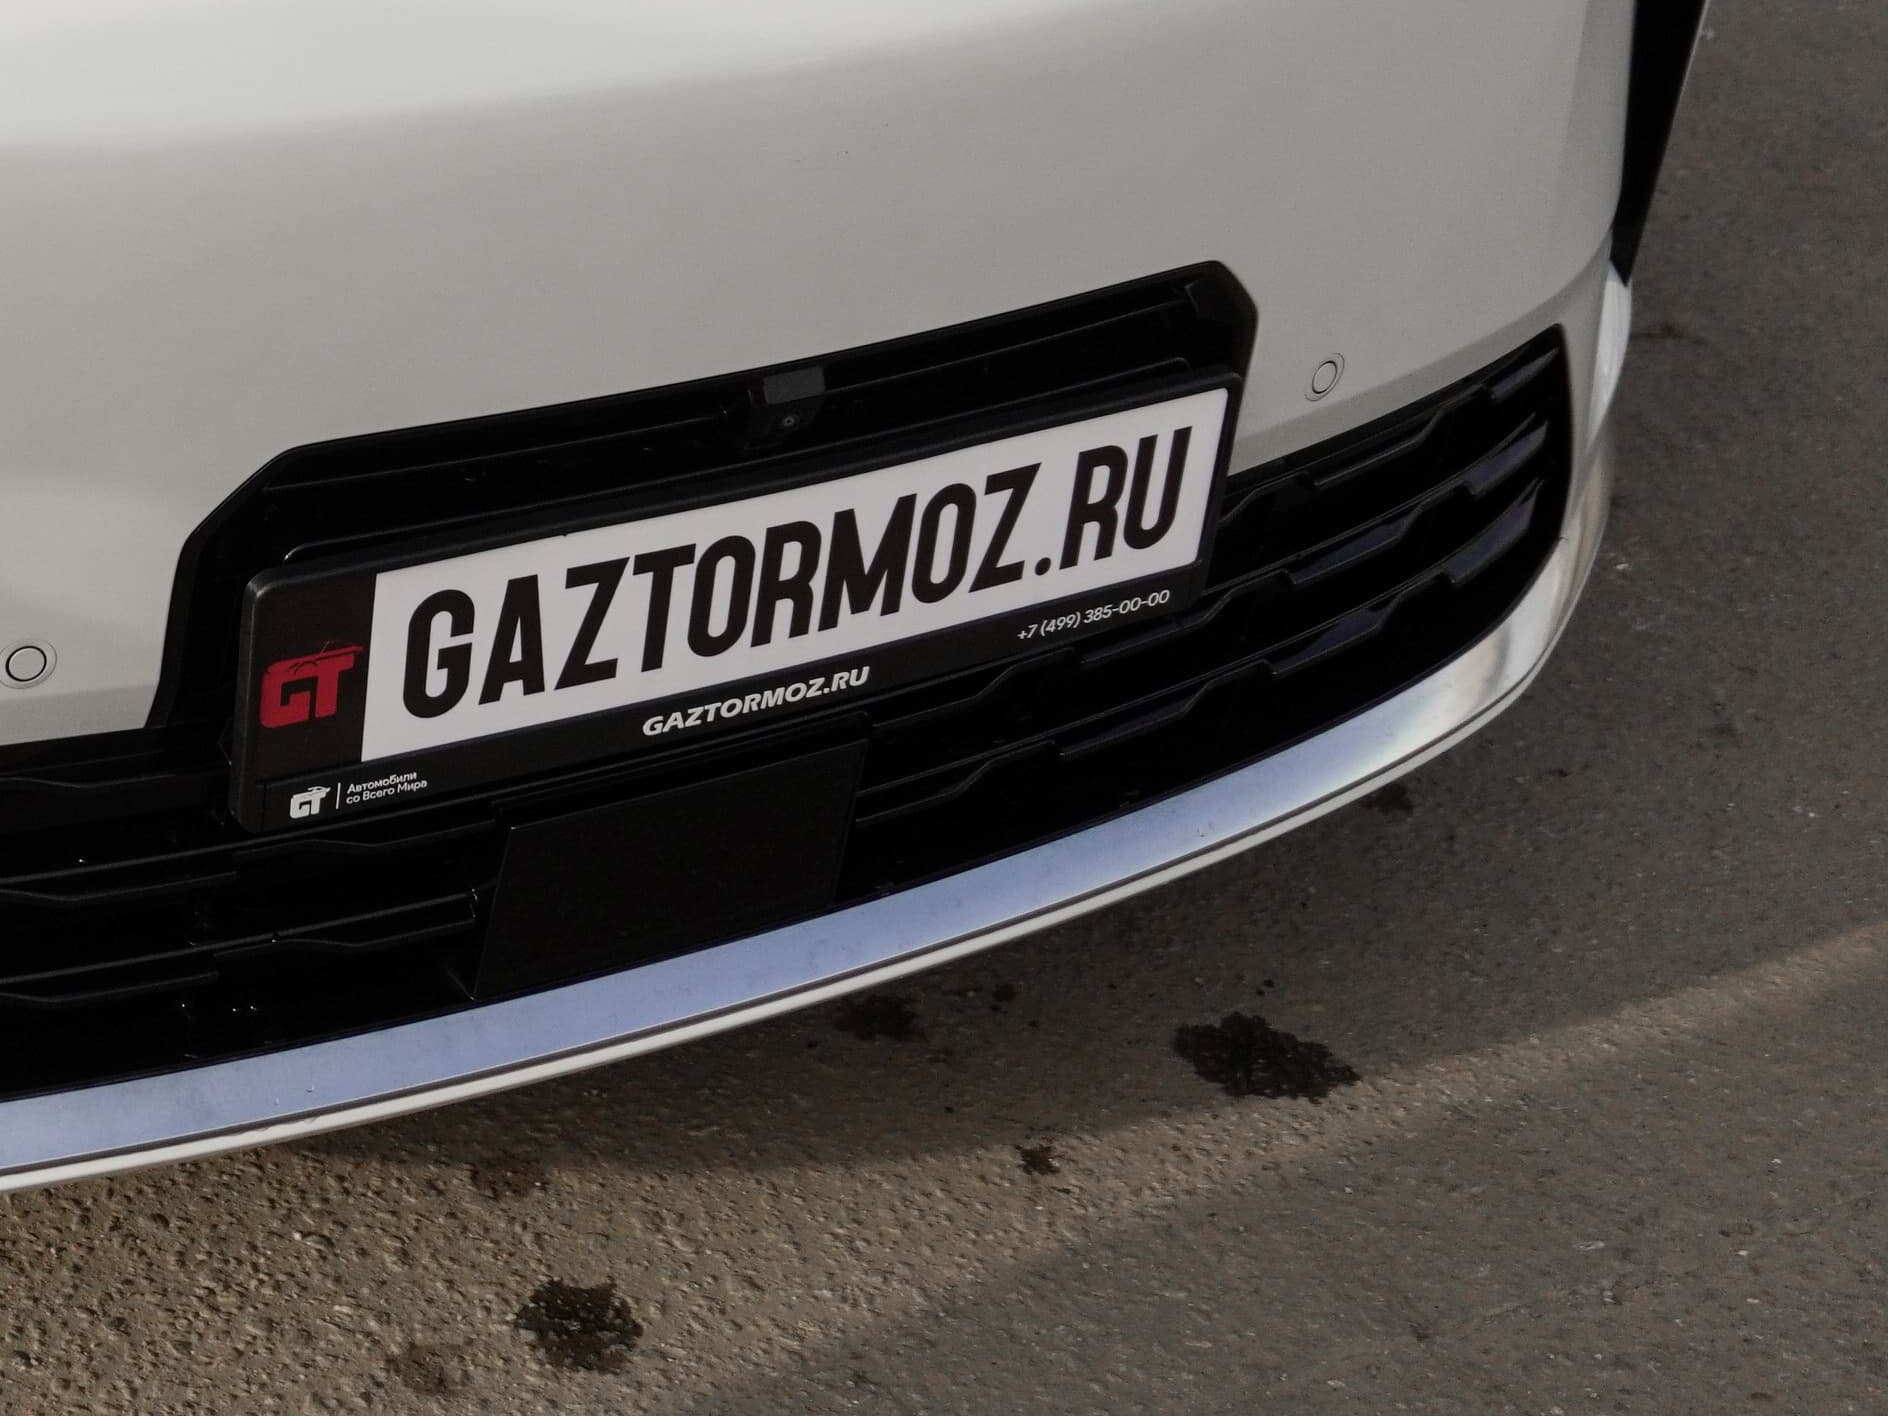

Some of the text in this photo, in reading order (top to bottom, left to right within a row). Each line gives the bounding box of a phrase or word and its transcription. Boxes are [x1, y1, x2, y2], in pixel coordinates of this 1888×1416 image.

[401, 425, 1194, 719] GAZTORMOZ.RU
[1017, 589, 1170, 640] +7 (499) 385-00-00
[259, 644, 364, 728] GT
[642, 665, 870, 736] GAZTORMOZ.RU
[289, 786, 331, 819] GT
[346, 772, 418, 794] Автомобили
[346, 780, 428, 805] со Всего Мира
